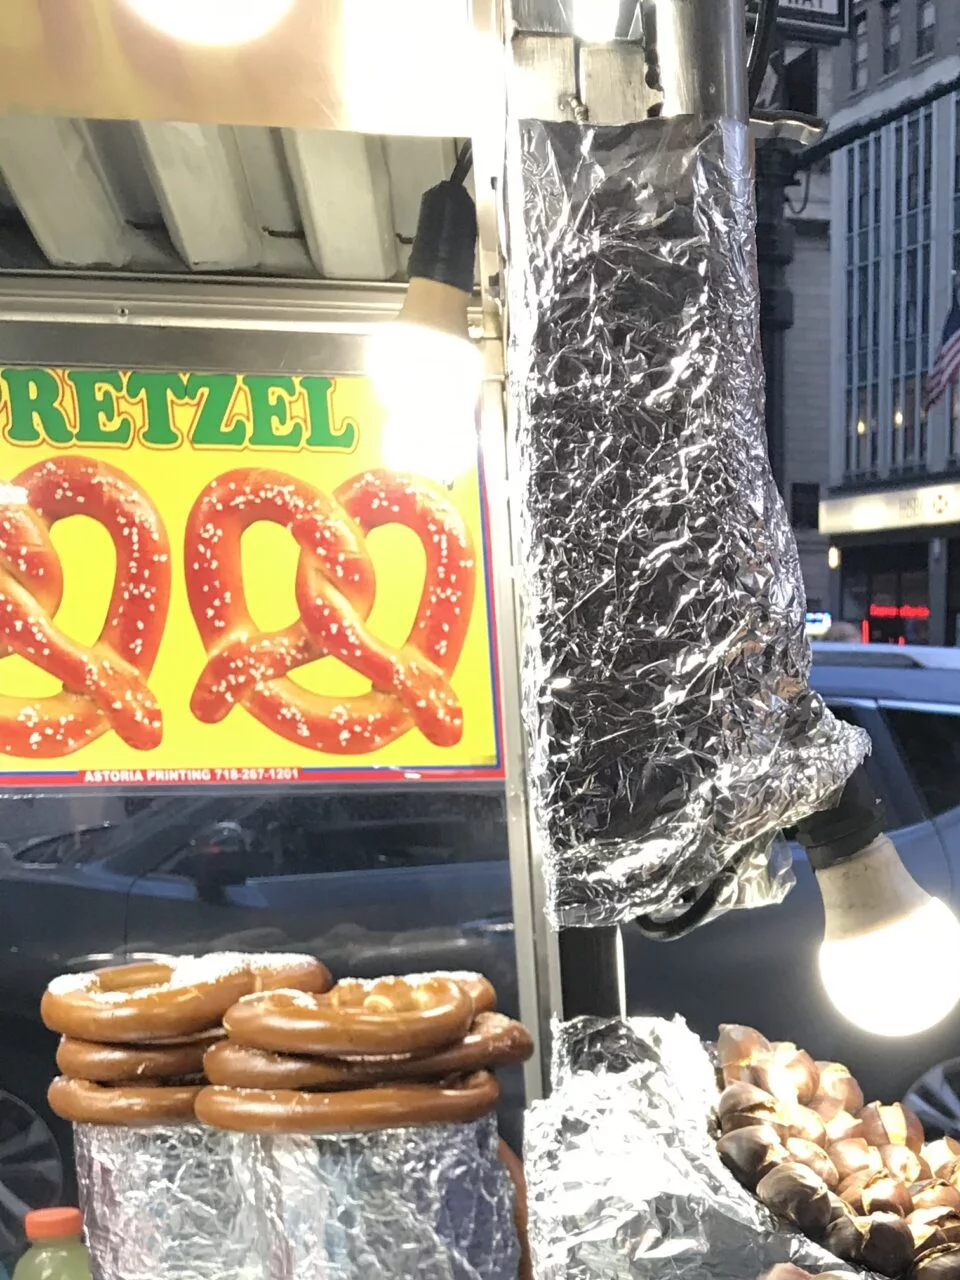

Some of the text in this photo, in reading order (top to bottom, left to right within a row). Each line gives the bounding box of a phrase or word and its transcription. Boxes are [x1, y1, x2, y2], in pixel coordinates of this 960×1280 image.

[0, 367, 358, 450] RETZEL
[84, 768, 299, 782] ASTORIA PRINTING 718-267-1201
